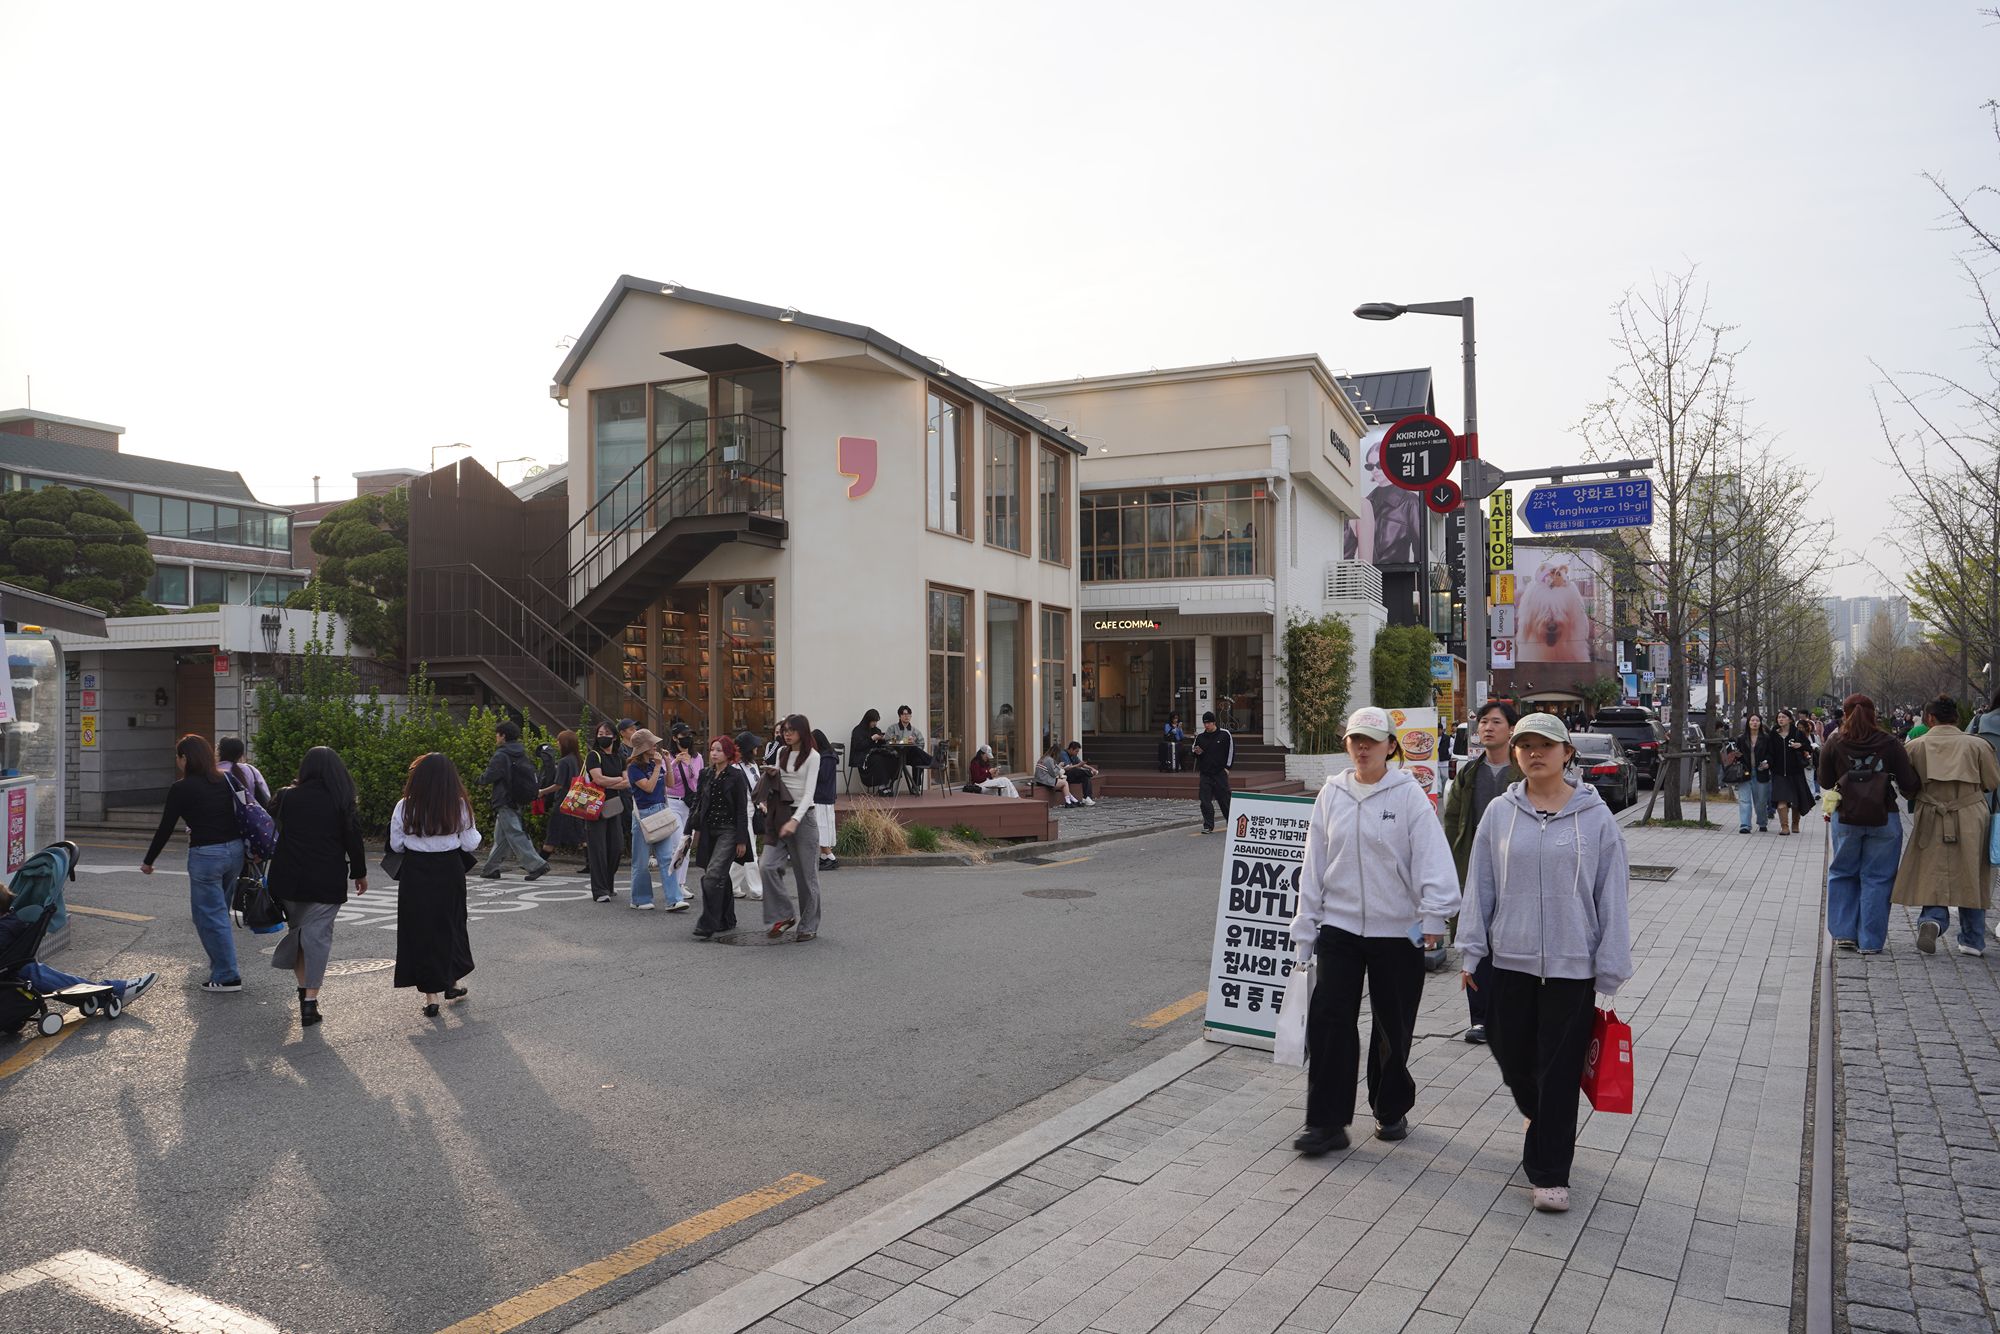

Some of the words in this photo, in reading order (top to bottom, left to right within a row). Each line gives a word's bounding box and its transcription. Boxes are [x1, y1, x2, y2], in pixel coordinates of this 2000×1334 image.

[1396, 431, 1417, 440] KKIRI
[1417, 429, 1440, 438] ROAD
[1419, 450, 1429, 476] 1
[1534, 491, 1557, 500] 22-34
[1573, 483, 1648, 503] 양화로19길
[1533, 501, 1550, 509] 22-1
[1552, 504, 1615, 517] Yanghwa-ro
[1618, 500, 1648, 513] 19-gil
[1491, 494, 1504, 566] TATTOO
[1094, 621, 1117, 630] CAFE
[1497, 610, 1505, 634] Ordinary
[1250, 816, 1273, 826] 방문이
[1275, 818, 1297, 828] 기부가
[1250, 827, 1267, 840] 착한
[1234, 844, 1289, 857] ABANDONED
[1231, 859, 1286, 890] DAY
[1224, 951, 1277, 976] 집사의
